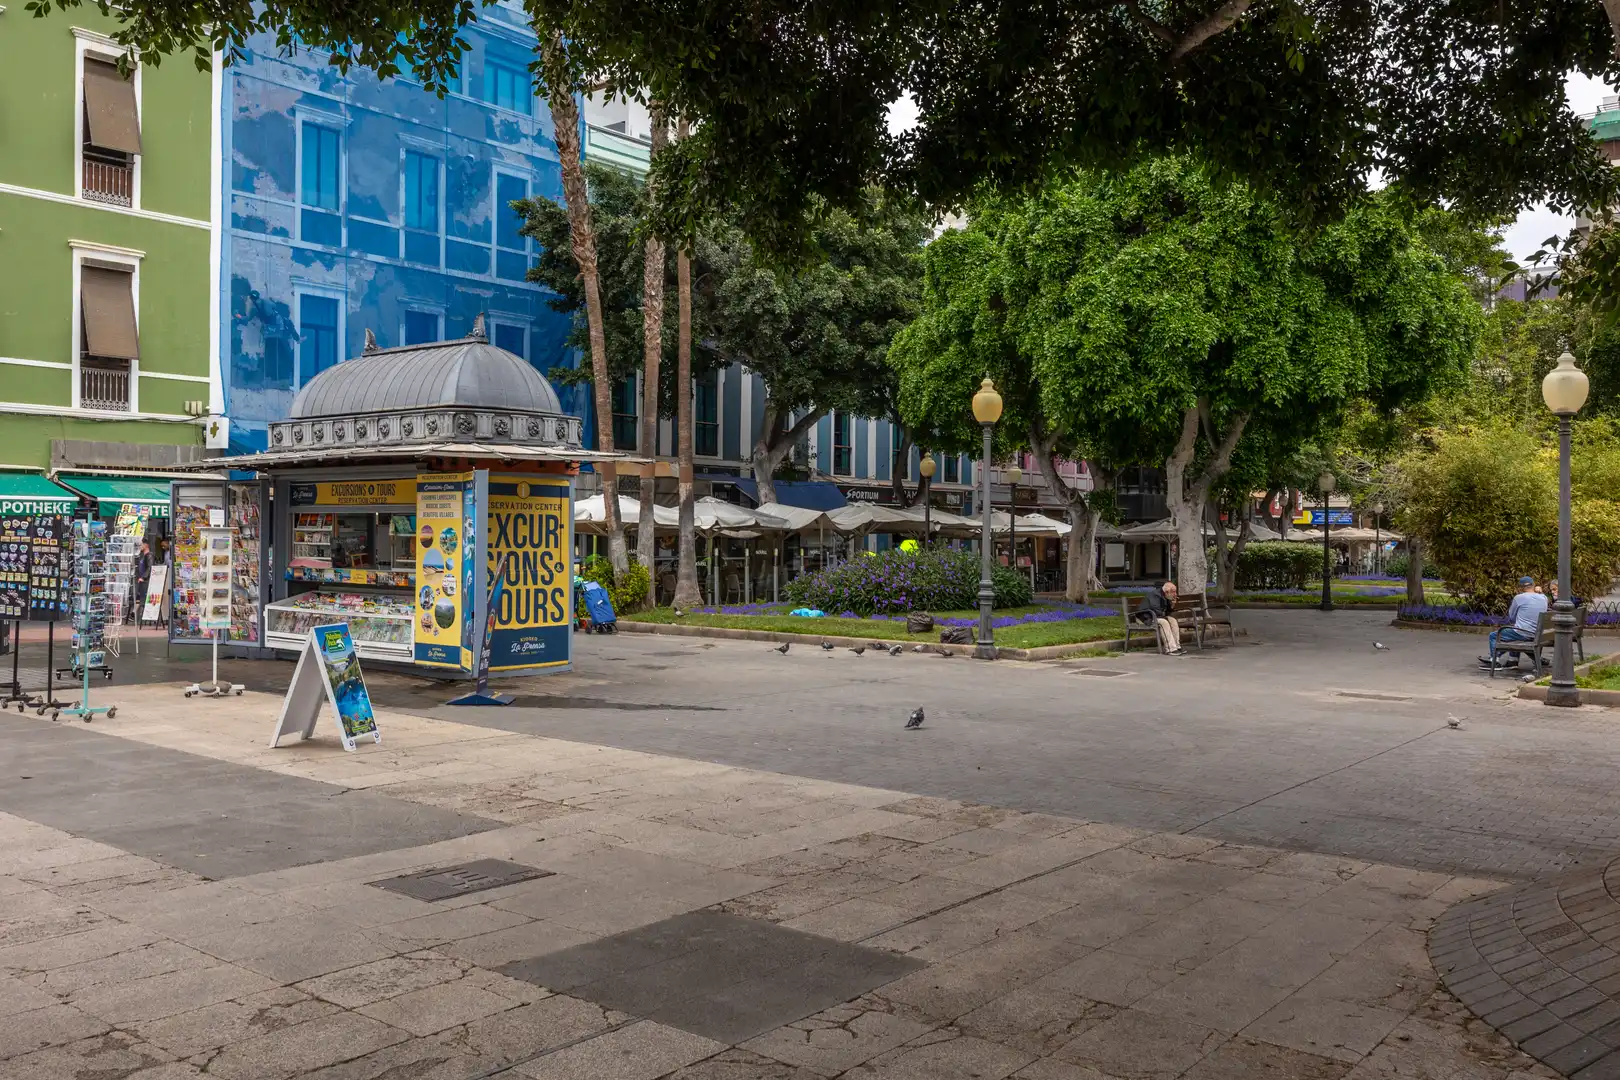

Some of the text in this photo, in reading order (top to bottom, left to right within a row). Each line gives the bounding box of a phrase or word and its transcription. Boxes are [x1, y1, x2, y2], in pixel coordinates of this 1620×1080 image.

[331, 484, 366, 496] EXCURSIONS
[377, 483, 396, 496] TOURS
[845, 488, 879, 500] SPORTIUM
[0, 501, 71, 514] POTHEKE
[535, 503, 562, 511] CENTER
[488, 588, 565, 626] OURS
